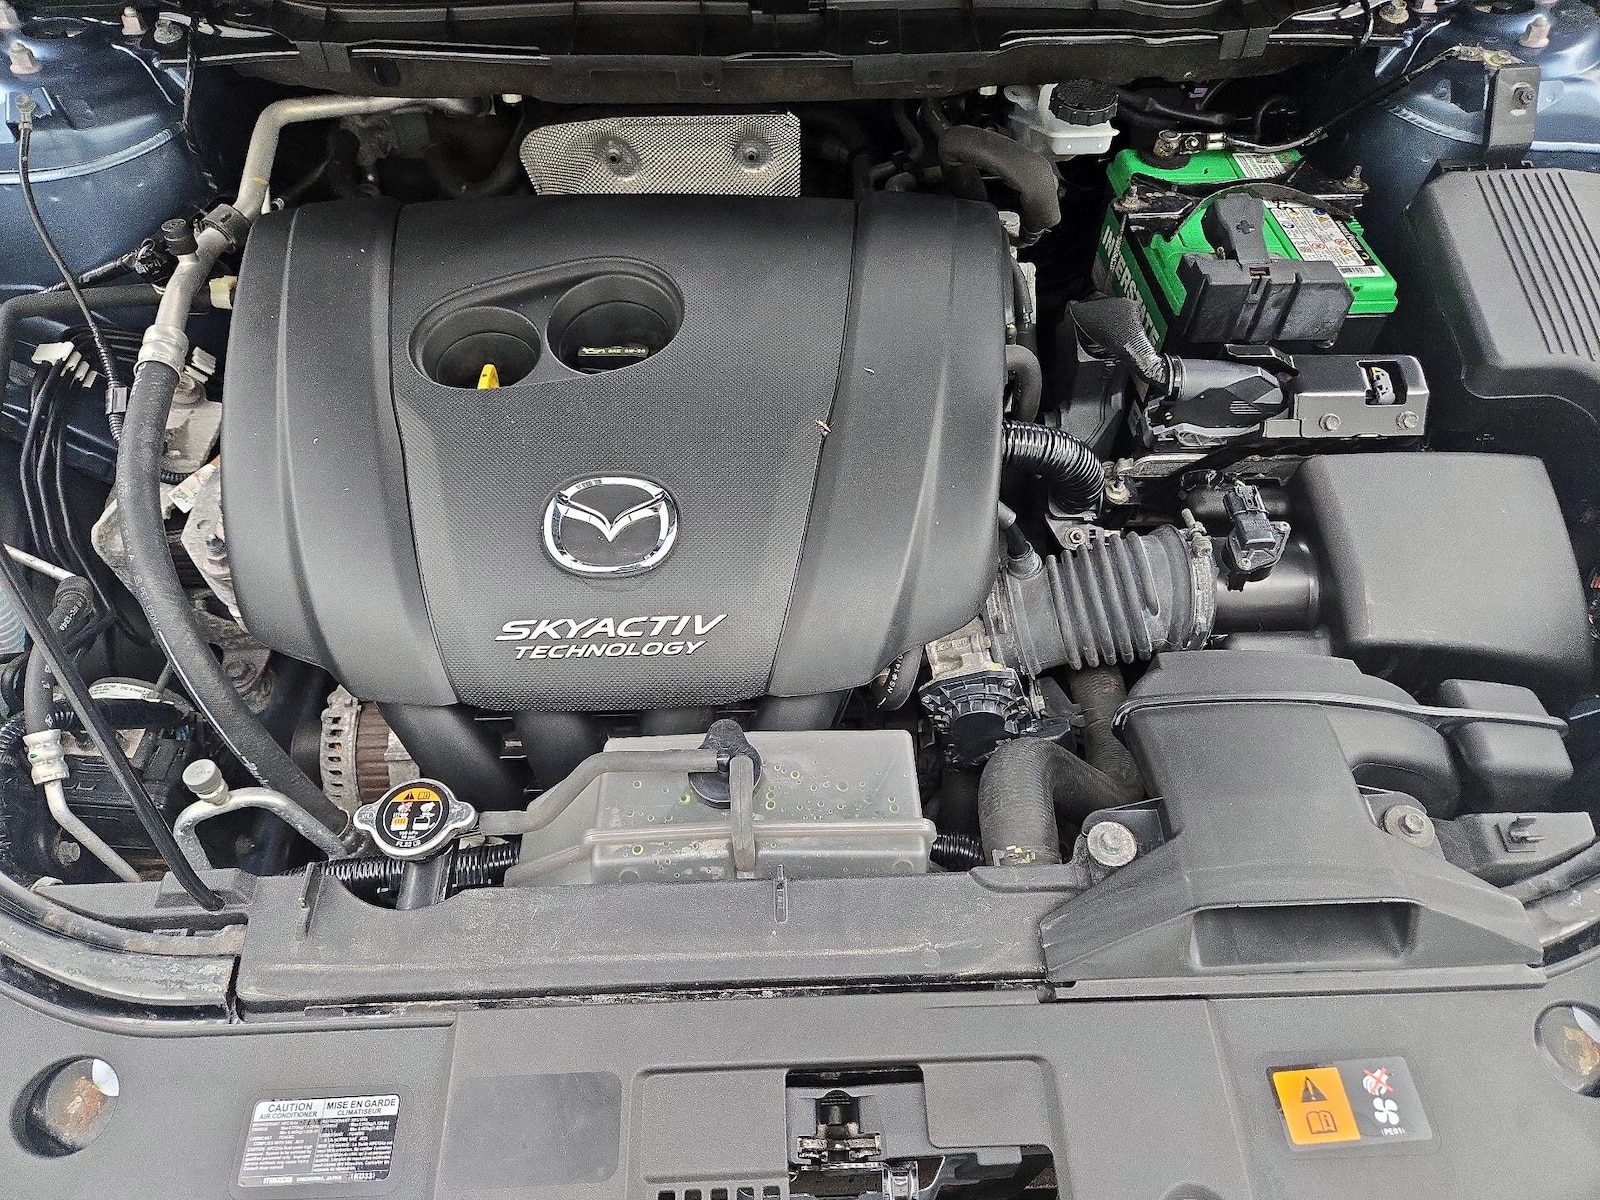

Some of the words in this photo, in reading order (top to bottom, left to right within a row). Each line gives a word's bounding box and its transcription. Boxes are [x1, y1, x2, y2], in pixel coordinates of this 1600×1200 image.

[1101, 225, 1160, 347] INERSTATE
[495, 614, 729, 641] SKYACTIV
[514, 640, 707, 660] TECHNOLOGY
[268, 1102, 313, 1113] CAUTION
[326, 1101, 349, 1110] MISE
[350, 1100, 363, 1109] EN
[364, 1098, 396, 1108] GARDE
[273, 1111, 318, 1119] CONDITIONER
[337, 1108, 382, 1116] CLIMATISEUR
[350, 1172, 376, 1180] (KD33)
